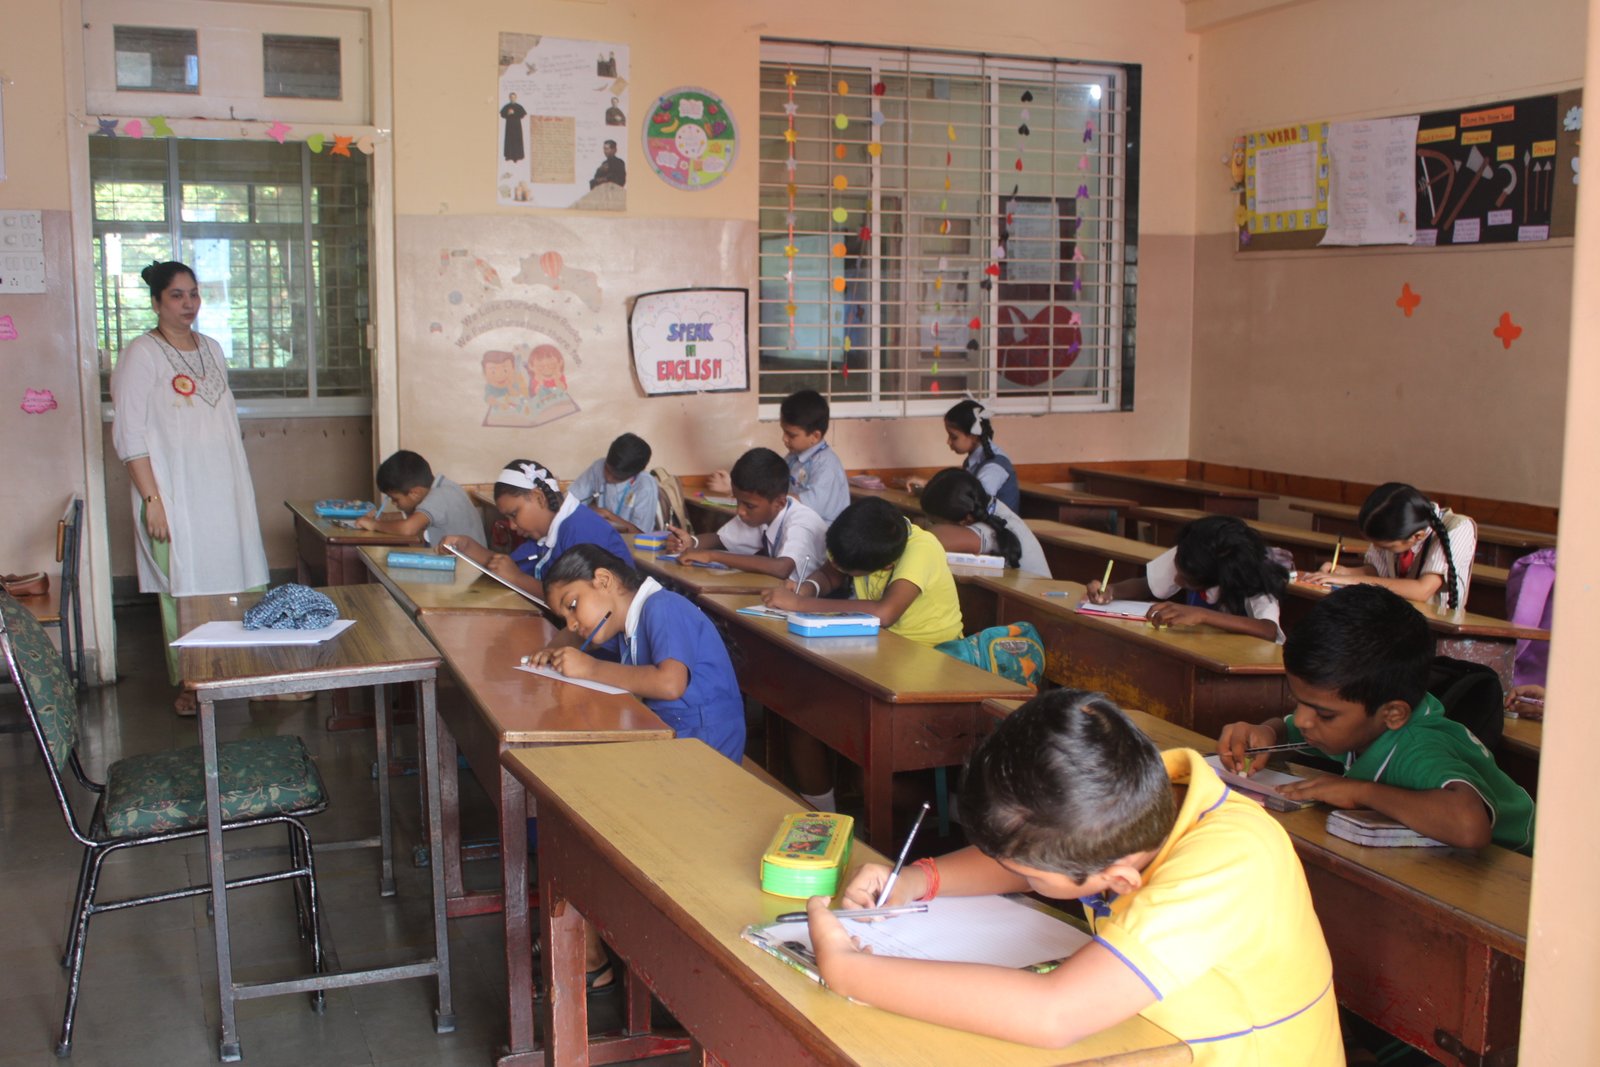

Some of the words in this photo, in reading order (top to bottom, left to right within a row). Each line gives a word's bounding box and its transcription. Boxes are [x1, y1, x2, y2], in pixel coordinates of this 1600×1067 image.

[1267, 128, 1297, 144] VERB
[667, 322, 714, 342] SPEAK
[685, 344, 697, 358] IN
[656, 358, 722, 382] ENGLISH
